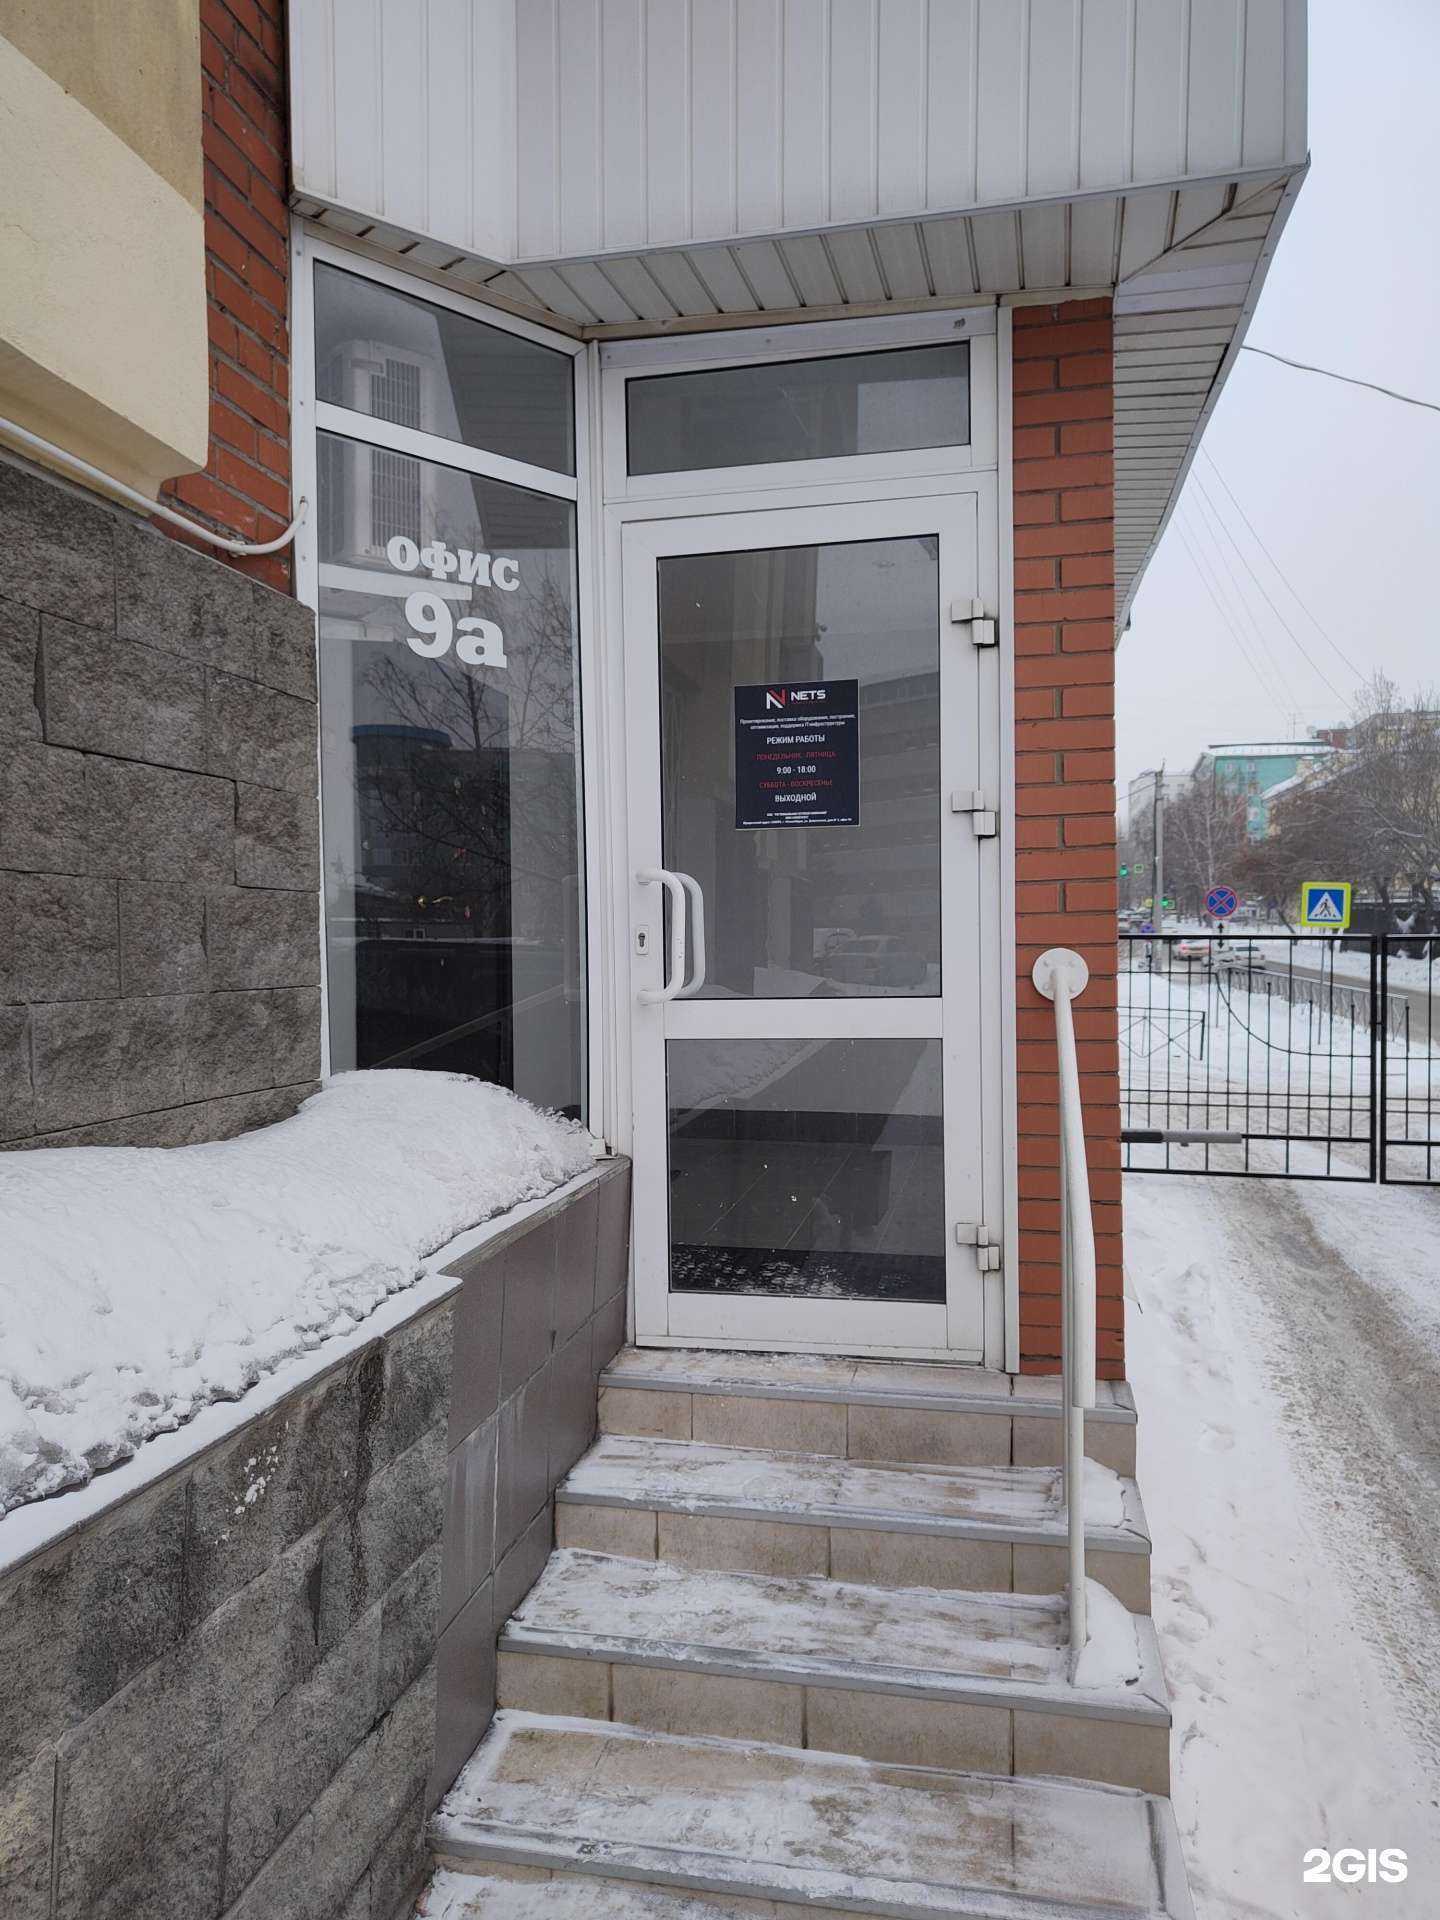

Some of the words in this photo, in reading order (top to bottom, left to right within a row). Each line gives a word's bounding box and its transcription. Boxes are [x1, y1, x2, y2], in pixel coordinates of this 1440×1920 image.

[790, 689, 826, 701] NETS
[766, 736, 794, 745] РЕЖИМ
[795, 734, 826, 743] РАБОТЫ
[776, 766, 792, 775] 9:00
[797, 765, 817, 774] 18:00
[774, 792, 817, 803] ВЫХОДНОЙ
